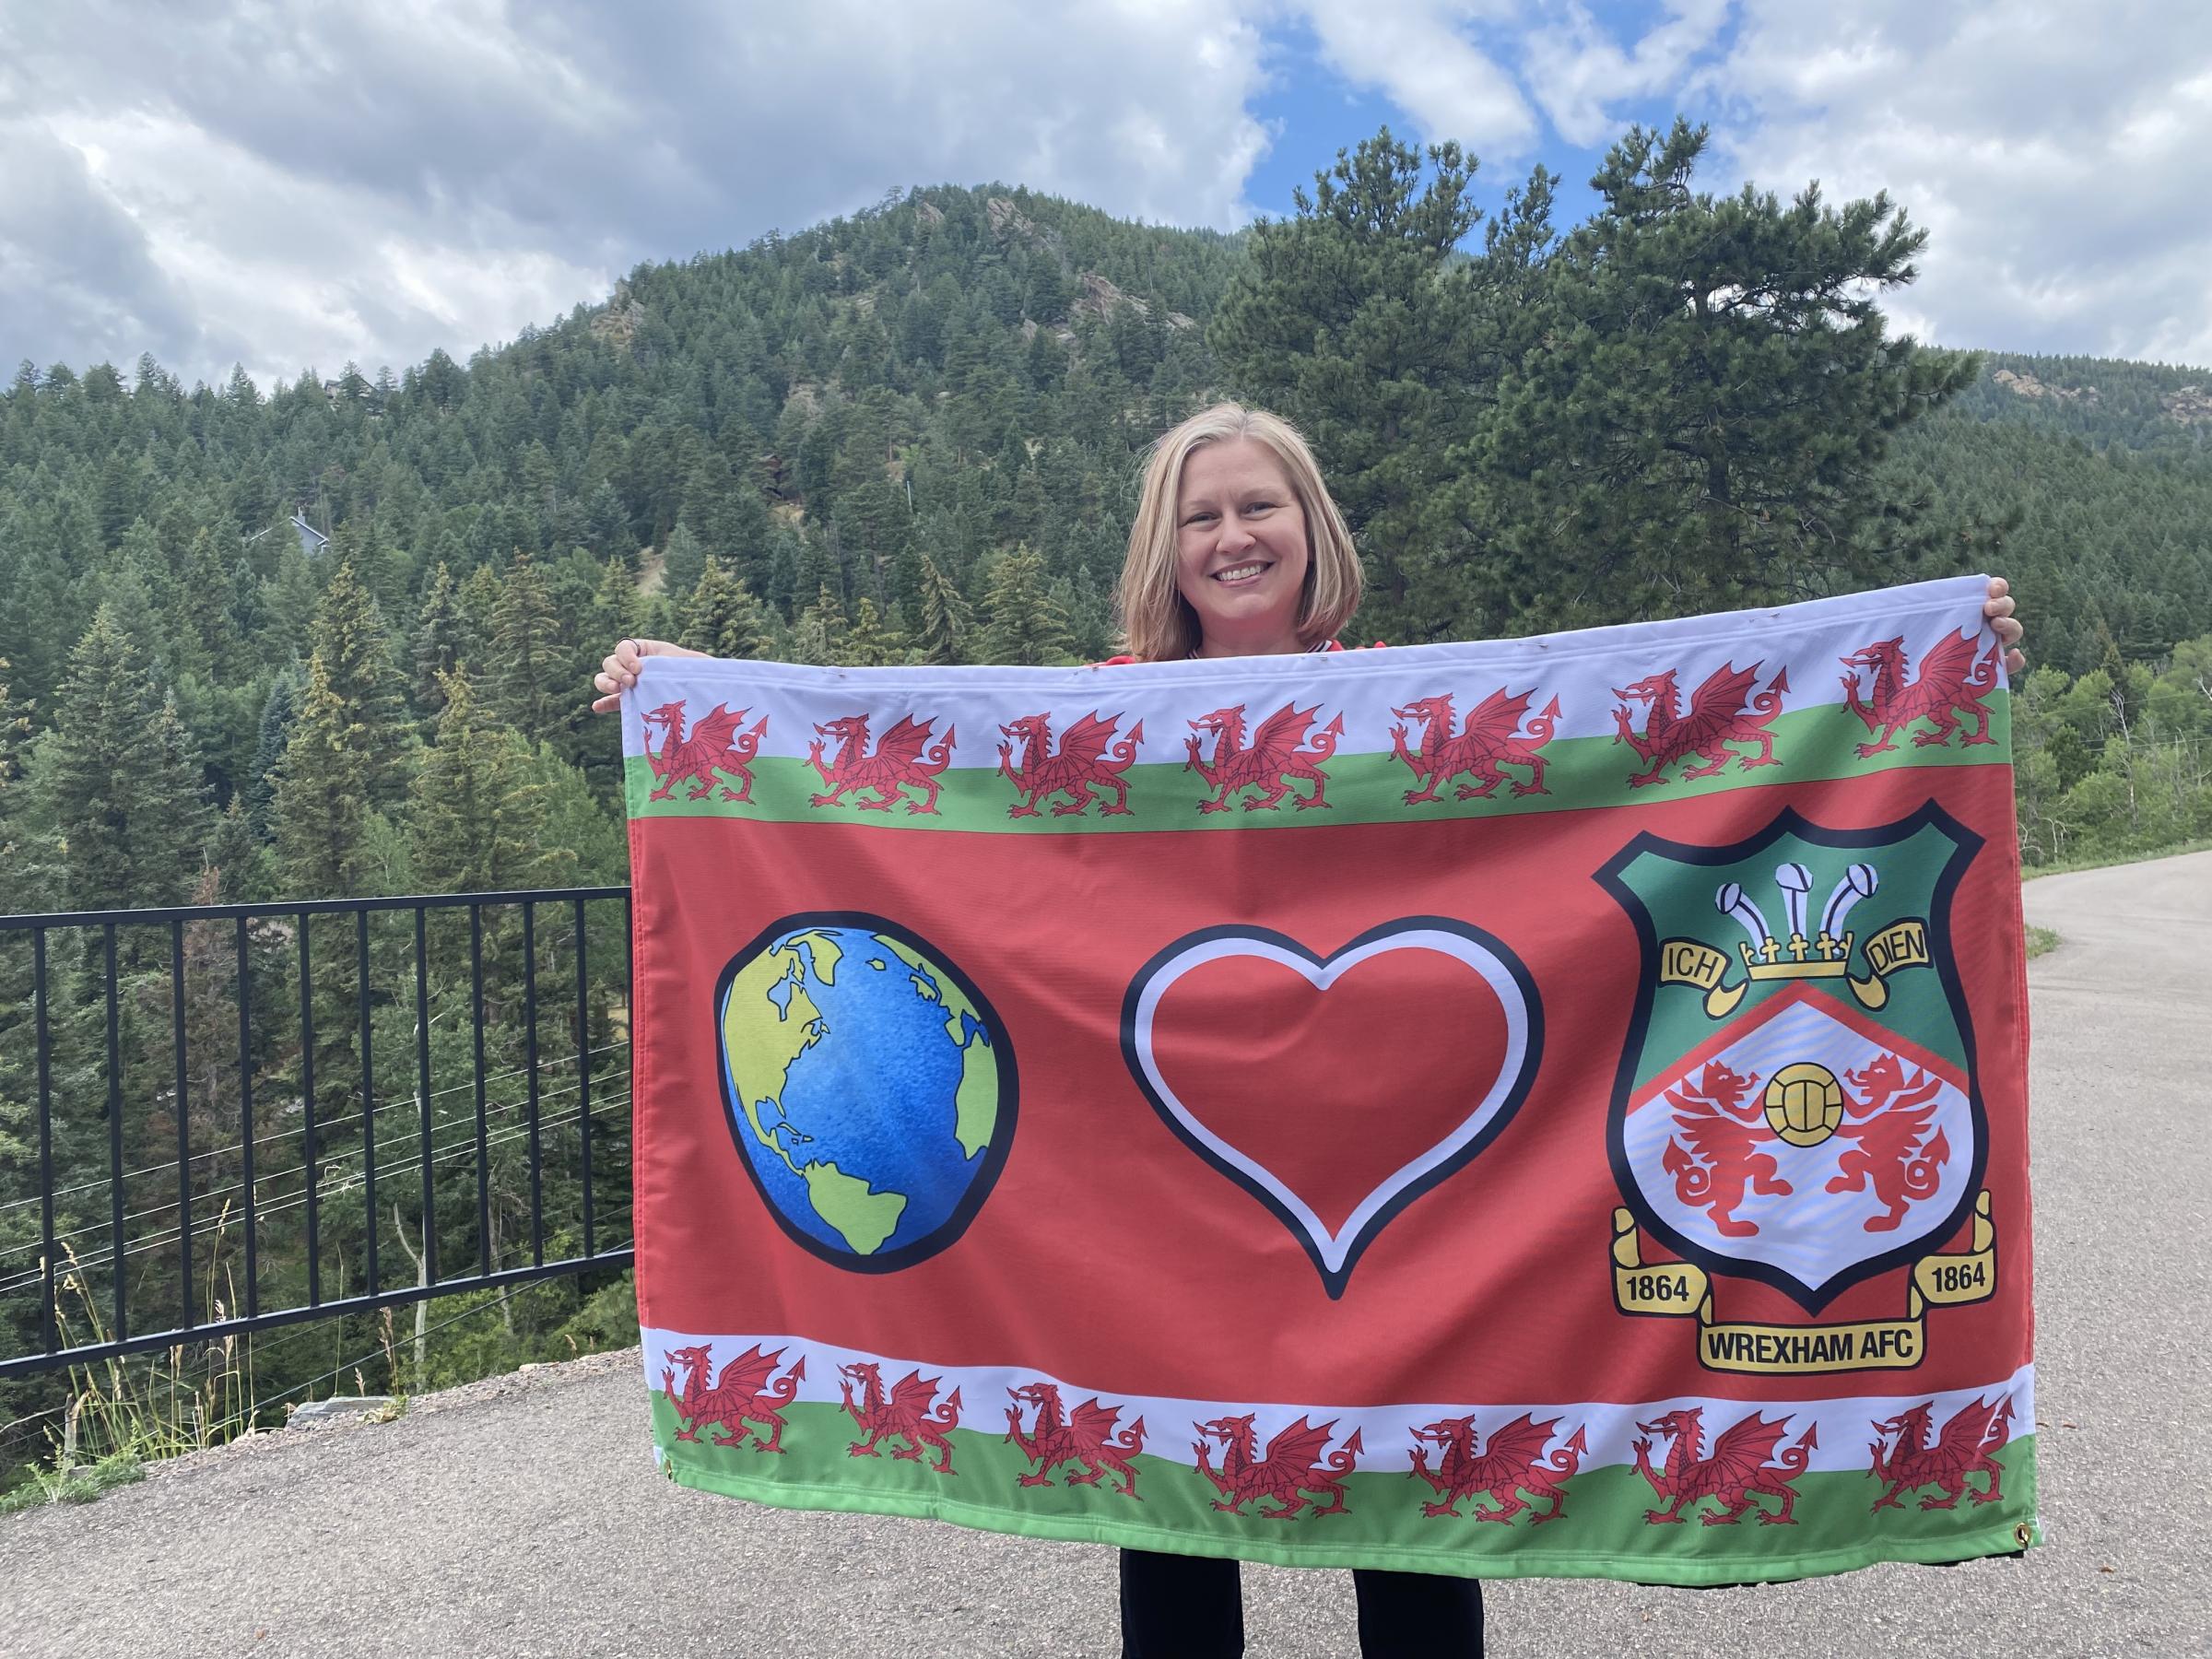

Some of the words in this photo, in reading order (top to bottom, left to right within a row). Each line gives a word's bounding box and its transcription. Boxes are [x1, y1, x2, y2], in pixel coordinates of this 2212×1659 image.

[1668, 947, 1719, 982] ICH
[1873, 929, 1925, 971] DIEN
[1626, 1275, 1689, 1301] 1864
[1931, 1262, 1985, 1293] 1864
[1707, 1334, 1853, 1363] WREXHAM
[1860, 1330, 1913, 1358] AFC
